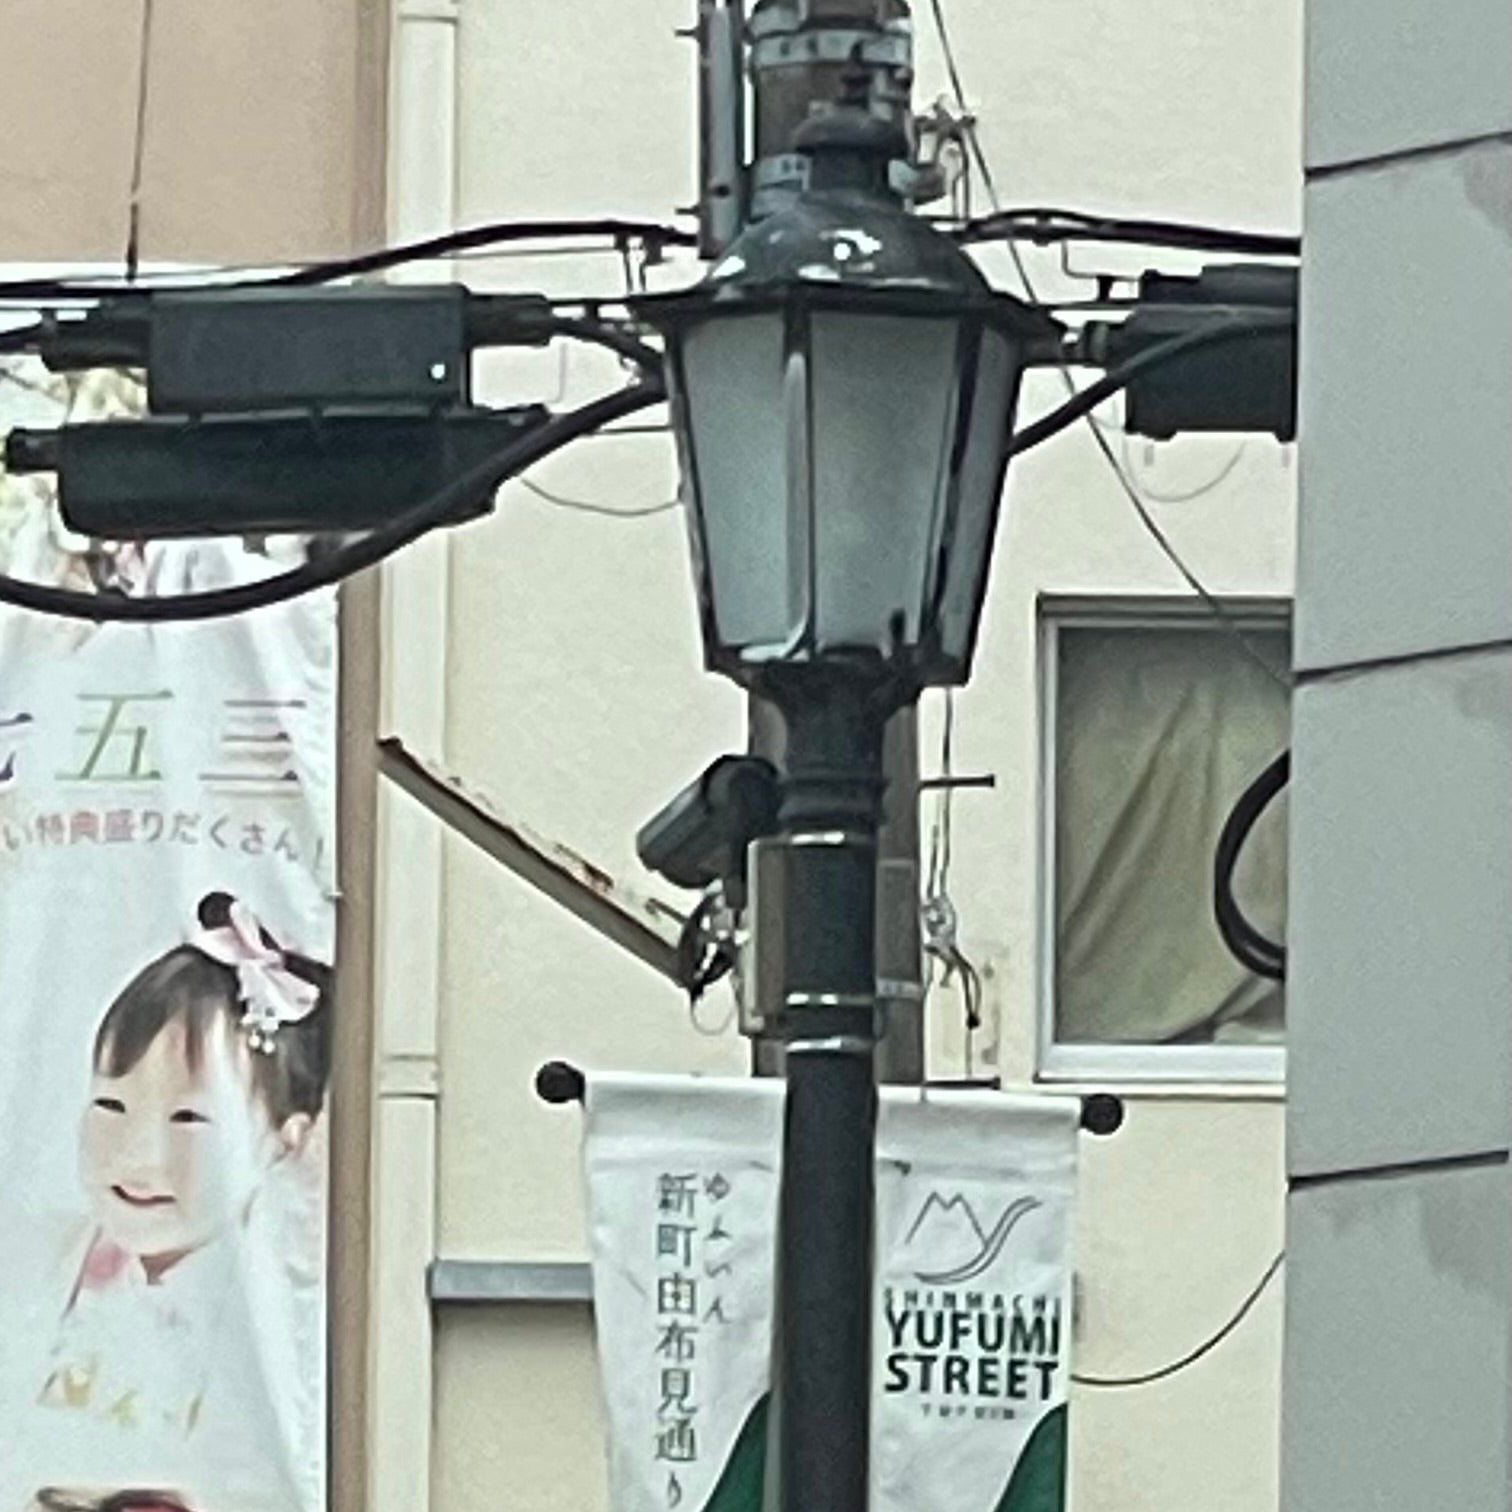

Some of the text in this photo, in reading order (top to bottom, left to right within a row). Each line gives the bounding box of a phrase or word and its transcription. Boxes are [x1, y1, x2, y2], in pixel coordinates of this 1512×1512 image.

[654, 1171, 699, 1509] 新町由布見通り
[885, 1308, 1061, 1355] YUFUMI
[884, 1353, 1059, 1400] STREET
